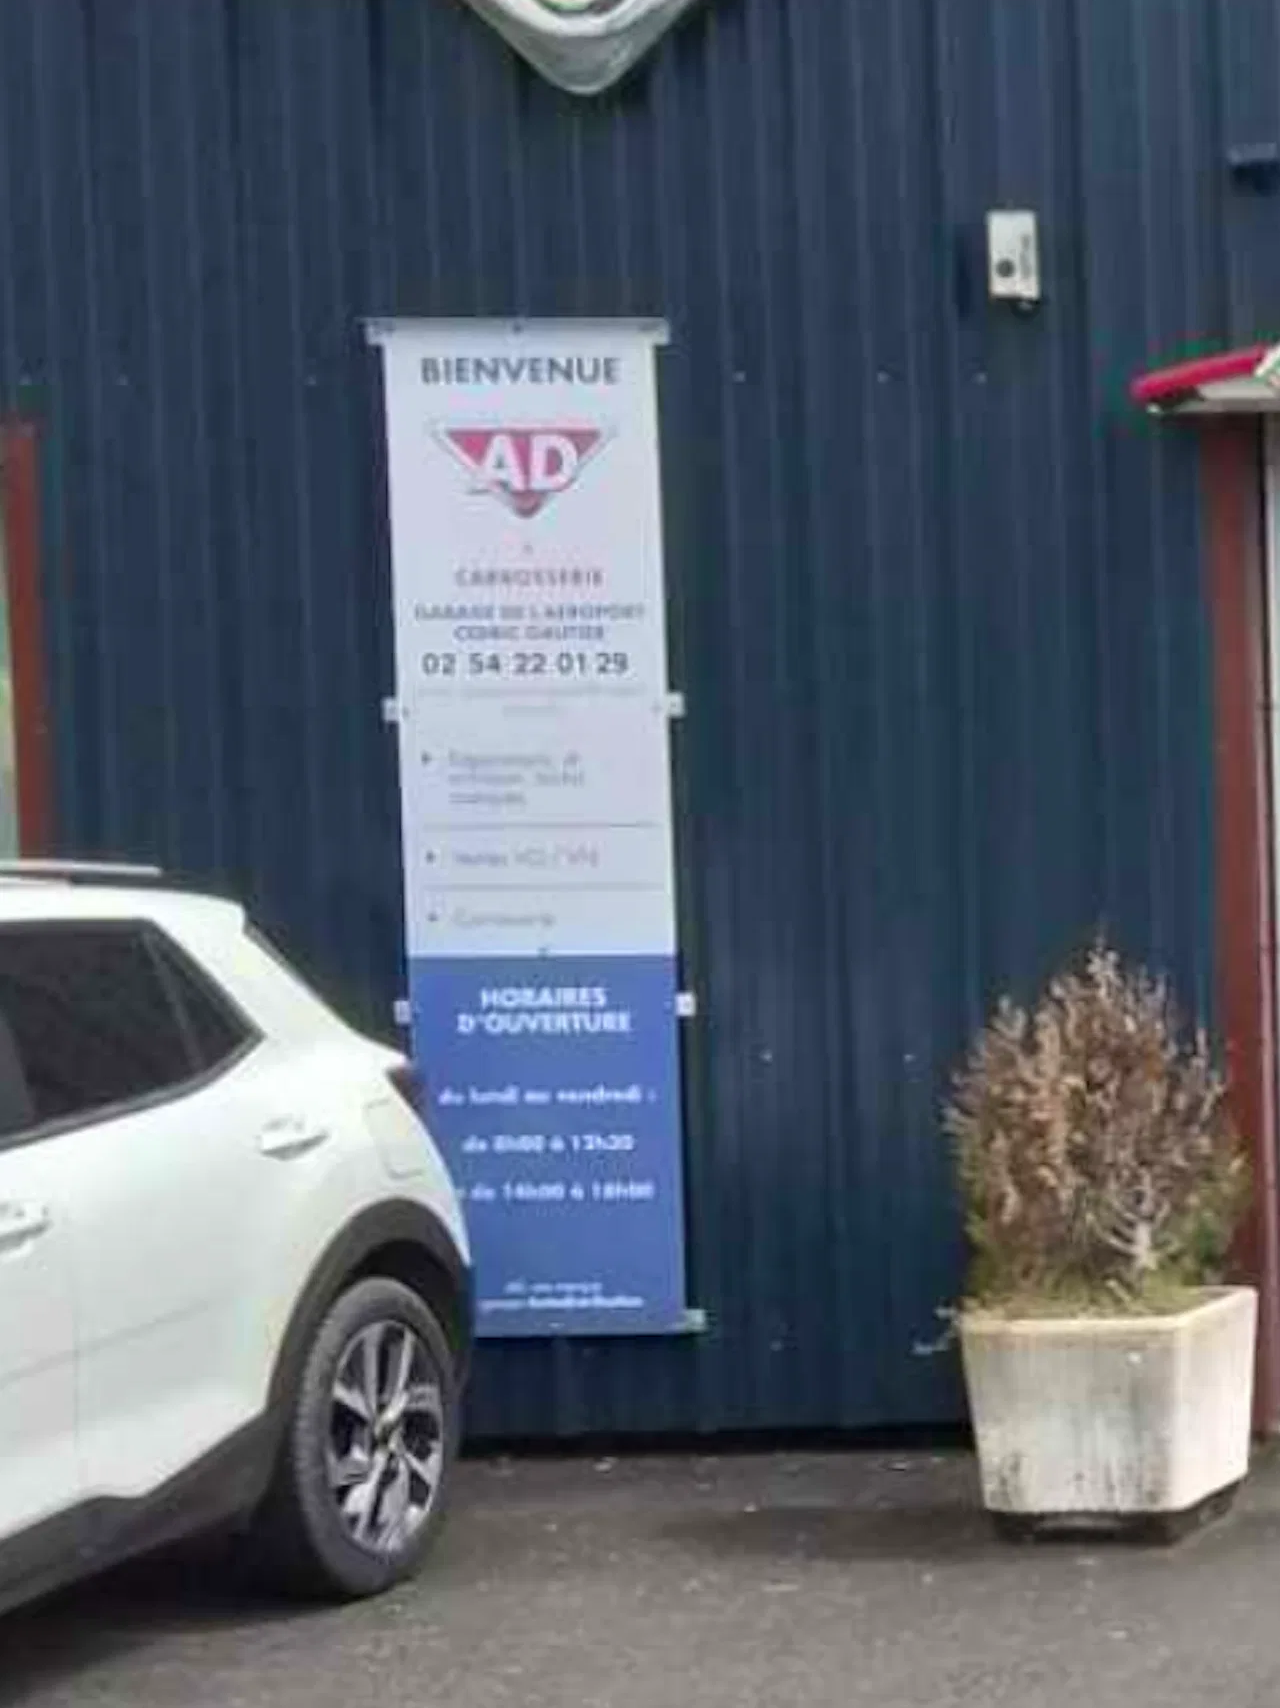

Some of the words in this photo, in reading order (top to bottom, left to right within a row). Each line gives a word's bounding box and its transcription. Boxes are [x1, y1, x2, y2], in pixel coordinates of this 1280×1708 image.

[419, 355, 622, 386] BIENVENUE
[479, 432, 580, 493] AD
[454, 567, 604, 588] CARROSSERIE
[421, 652, 457, 677] 02
[467, 652, 502, 677] 54
[511, 652, 548, 677] 22
[556, 652, 586, 677] 01
[480, 986, 607, 1009] HORAIRES
[456, 1011, 631, 1035] D'OUVERTURE
